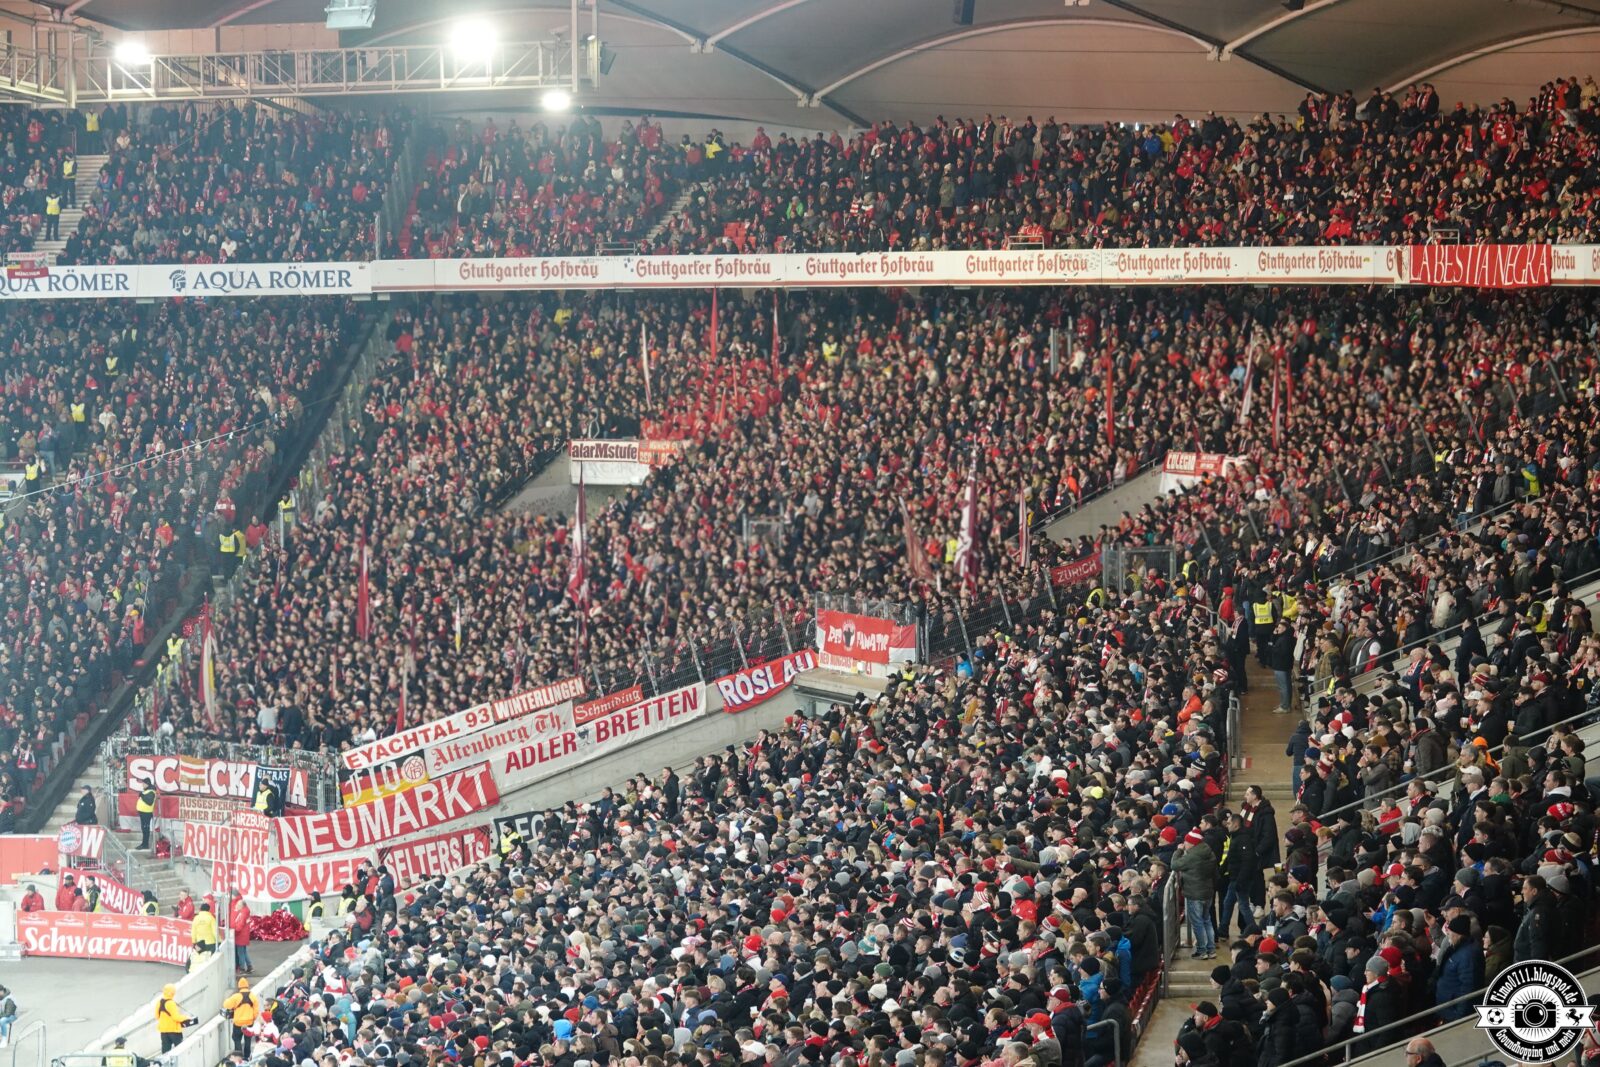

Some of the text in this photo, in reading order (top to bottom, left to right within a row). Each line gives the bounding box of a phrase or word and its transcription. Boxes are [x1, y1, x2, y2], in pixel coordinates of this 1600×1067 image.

[636, 258, 771, 280] Stuttgarter Hofbräu
[806, 255, 934, 278] Stuttgarter Hofbräu
[966, 254, 1034, 277] Stuttgarter
[1118, 251, 1231, 275] Stuttgarter Hofbräu
[1258, 250, 1316, 275] Stuttgarter
[1319, 249, 1363, 273] Hofbräu
[1409, 245, 1431, 283] LA
[1433, 244, 1488, 285] BESTIA
[1492, 244, 1549, 286] NEGRA
[48, 269, 129, 292] RÖMER
[193, 266, 352, 294] AQUA RÖMER
[572, 443, 637, 460] alarMstufe
[718, 651, 815, 707] RÖSLAU
[495, 677, 585, 720] WINTERLINGEN
[575, 690, 640, 721] Schmiding
[345, 708, 490, 768] EYACHTAL 93
[505, 687, 698, 774] ADLER BRETTEN
[432, 726, 530, 771] Altenburg
[180, 809, 209, 821] IMMER
[232, 811, 269, 829] HARZBURG
[278, 763, 487, 858] NEUMARKT
[183, 823, 268, 866] ROHRDORF
[212, 861, 251, 896] RED
[383, 837, 463, 889] SELTERS
